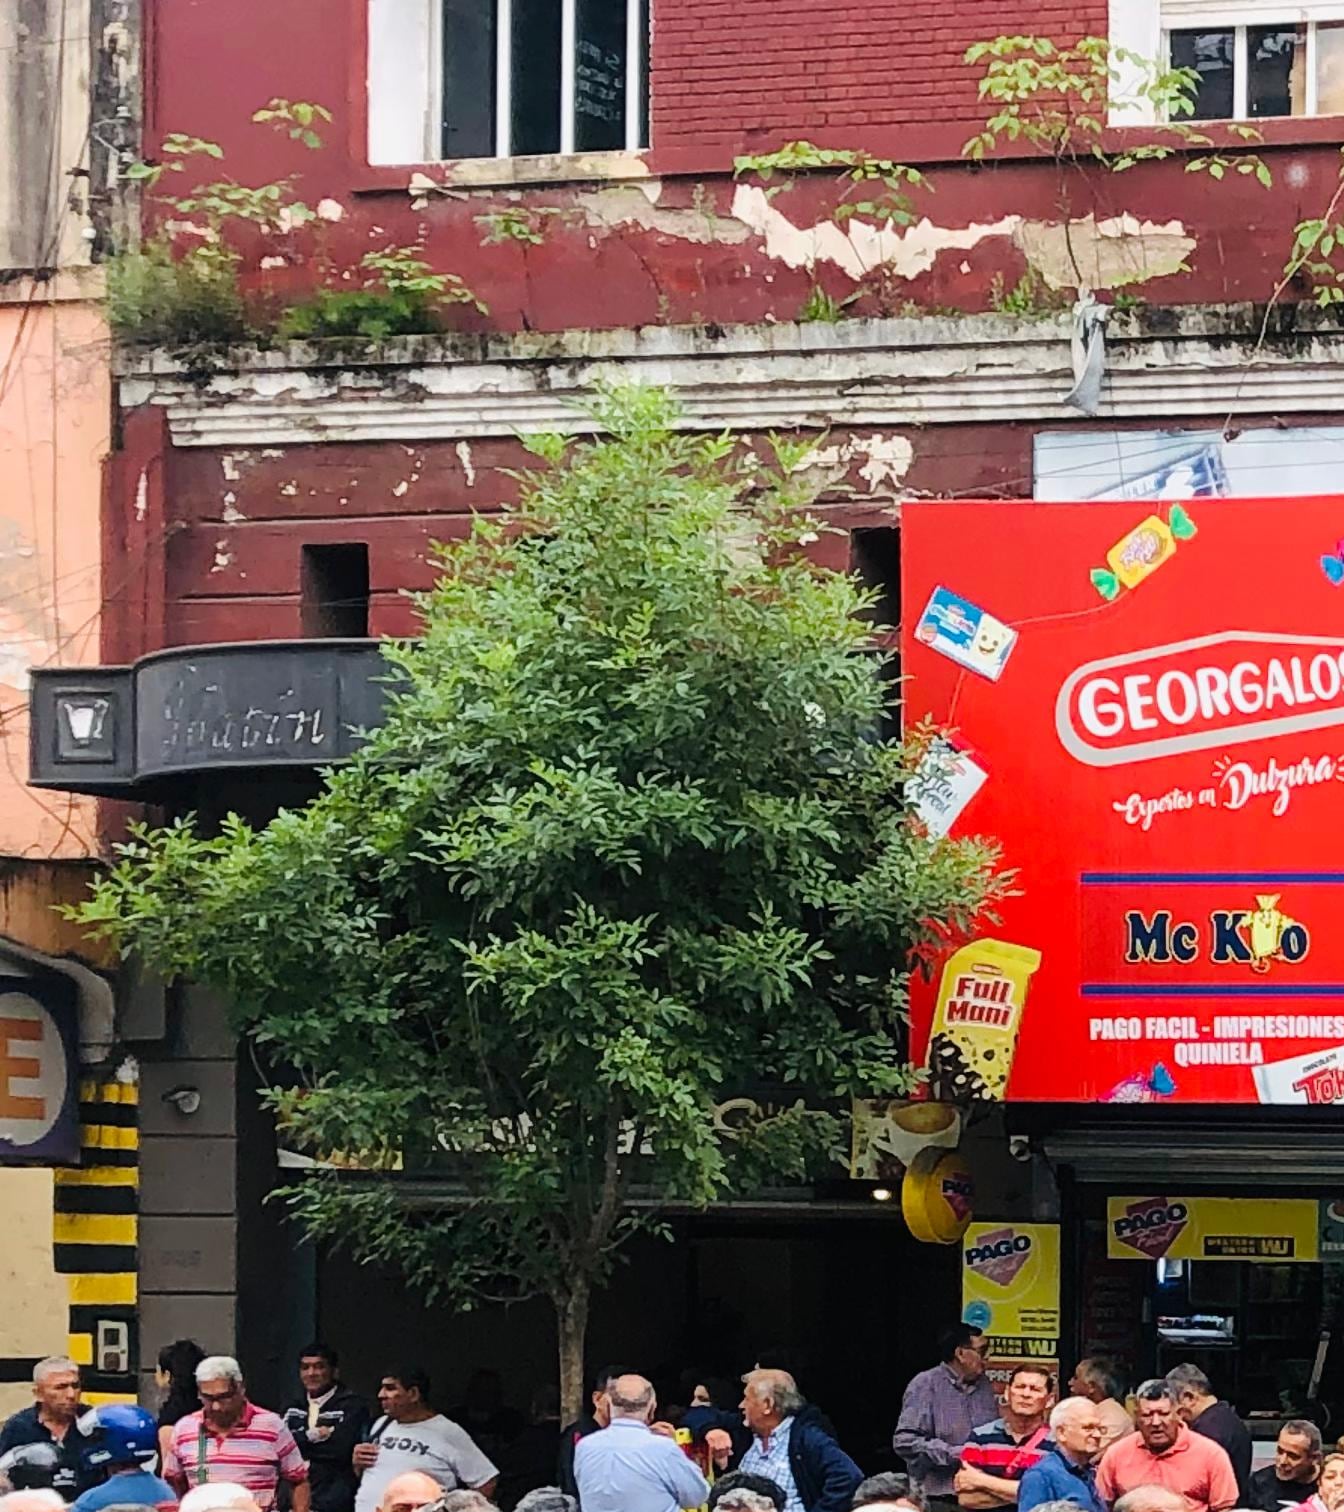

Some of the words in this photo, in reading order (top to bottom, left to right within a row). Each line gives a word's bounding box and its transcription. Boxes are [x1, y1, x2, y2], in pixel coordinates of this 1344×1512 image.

[1112, 788, 1194, 831] Expertos
[1198, 786, 1217, 807] en
[1219, 755, 1337, 817] Dulzura
[1125, 909, 1198, 963] Mc
[956, 976, 1010, 1004] Full
[1090, 1018, 1141, 1040] PAGO
[1145, 1017, 1199, 1040] FACIL
[1174, 1041, 1264, 1066] QUINIELA
[1114, 1203, 1187, 1236] PAGO
[965, 1236, 1031, 1264] PAGO
